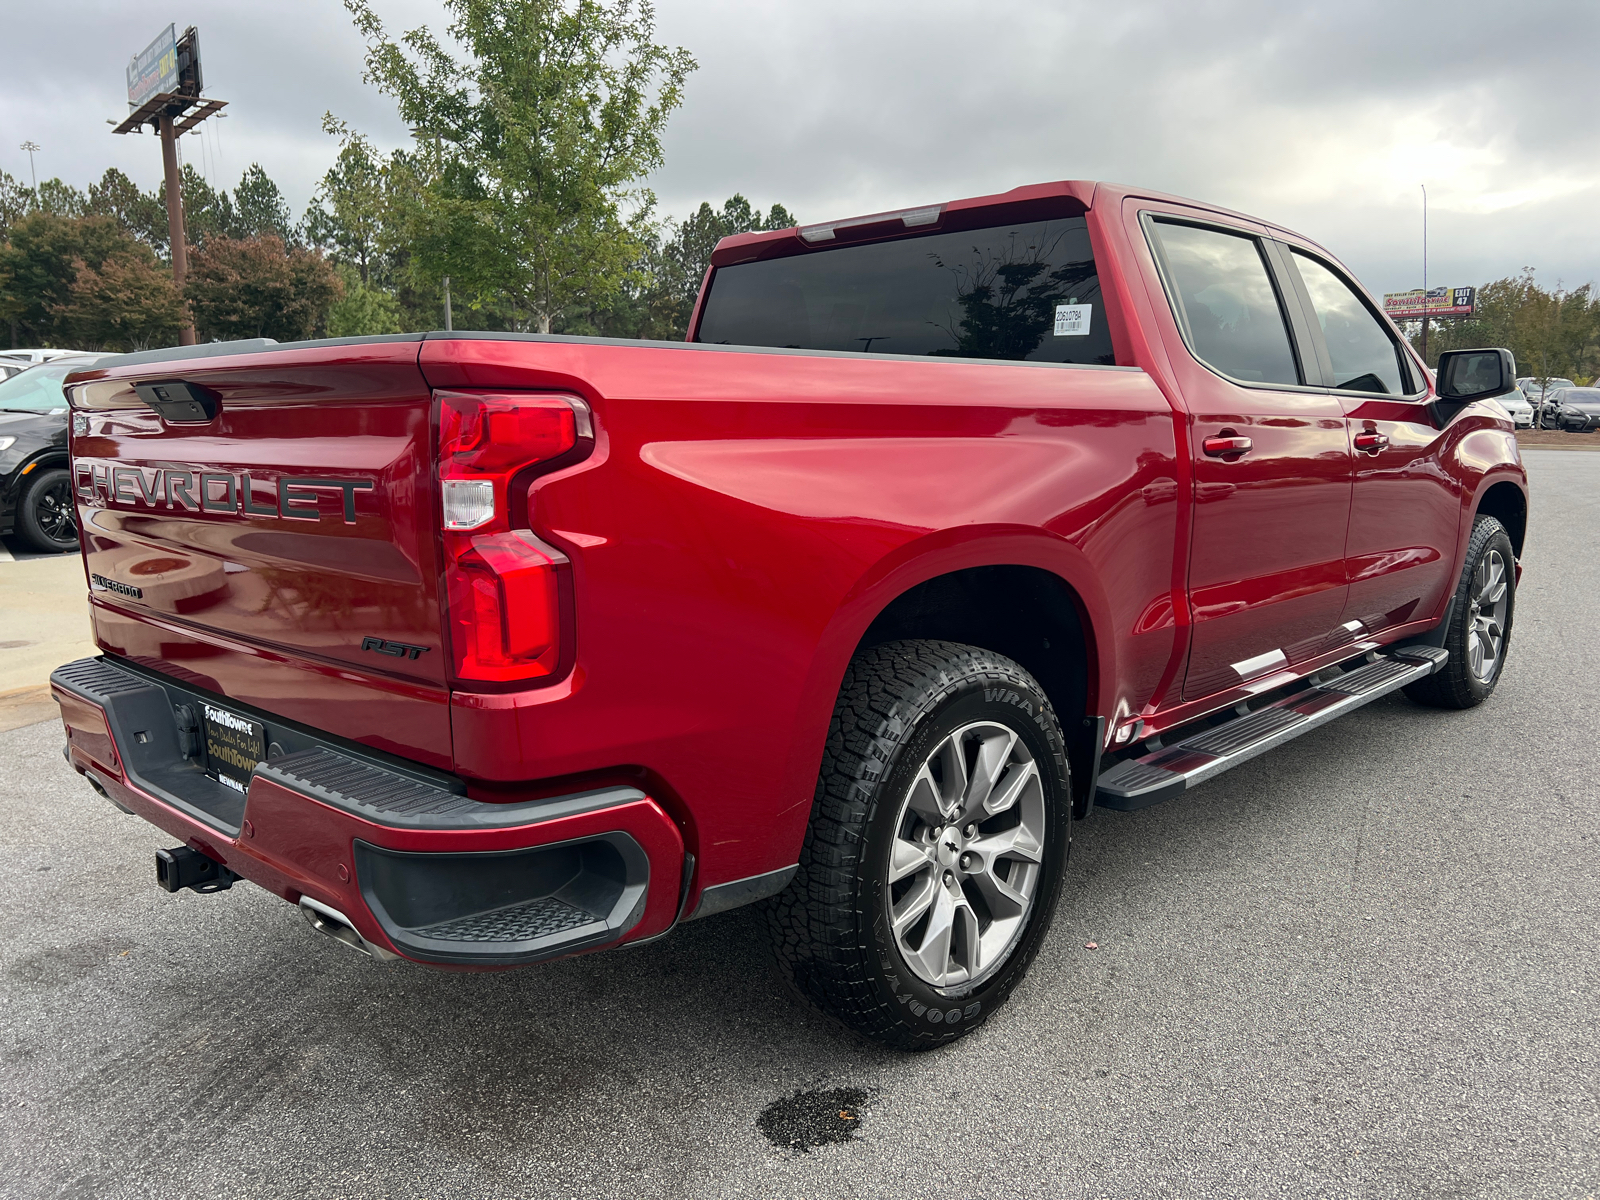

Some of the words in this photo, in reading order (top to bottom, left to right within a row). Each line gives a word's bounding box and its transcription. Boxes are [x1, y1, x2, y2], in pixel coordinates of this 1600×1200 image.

[1455, 289, 1471, 297] EXIT
[1456, 297, 1468, 306] 47
[74, 463, 374, 526] CHEVROLET
[91, 573, 143, 599] SILVERADO
[361, 636, 431, 660] RST
[220, 728, 236, 746] Dealer
[247, 738, 261, 759] Life!
[983, 688, 1069, 827] WRANGLER
[872, 879, 982, 1024] GOODYEAR
